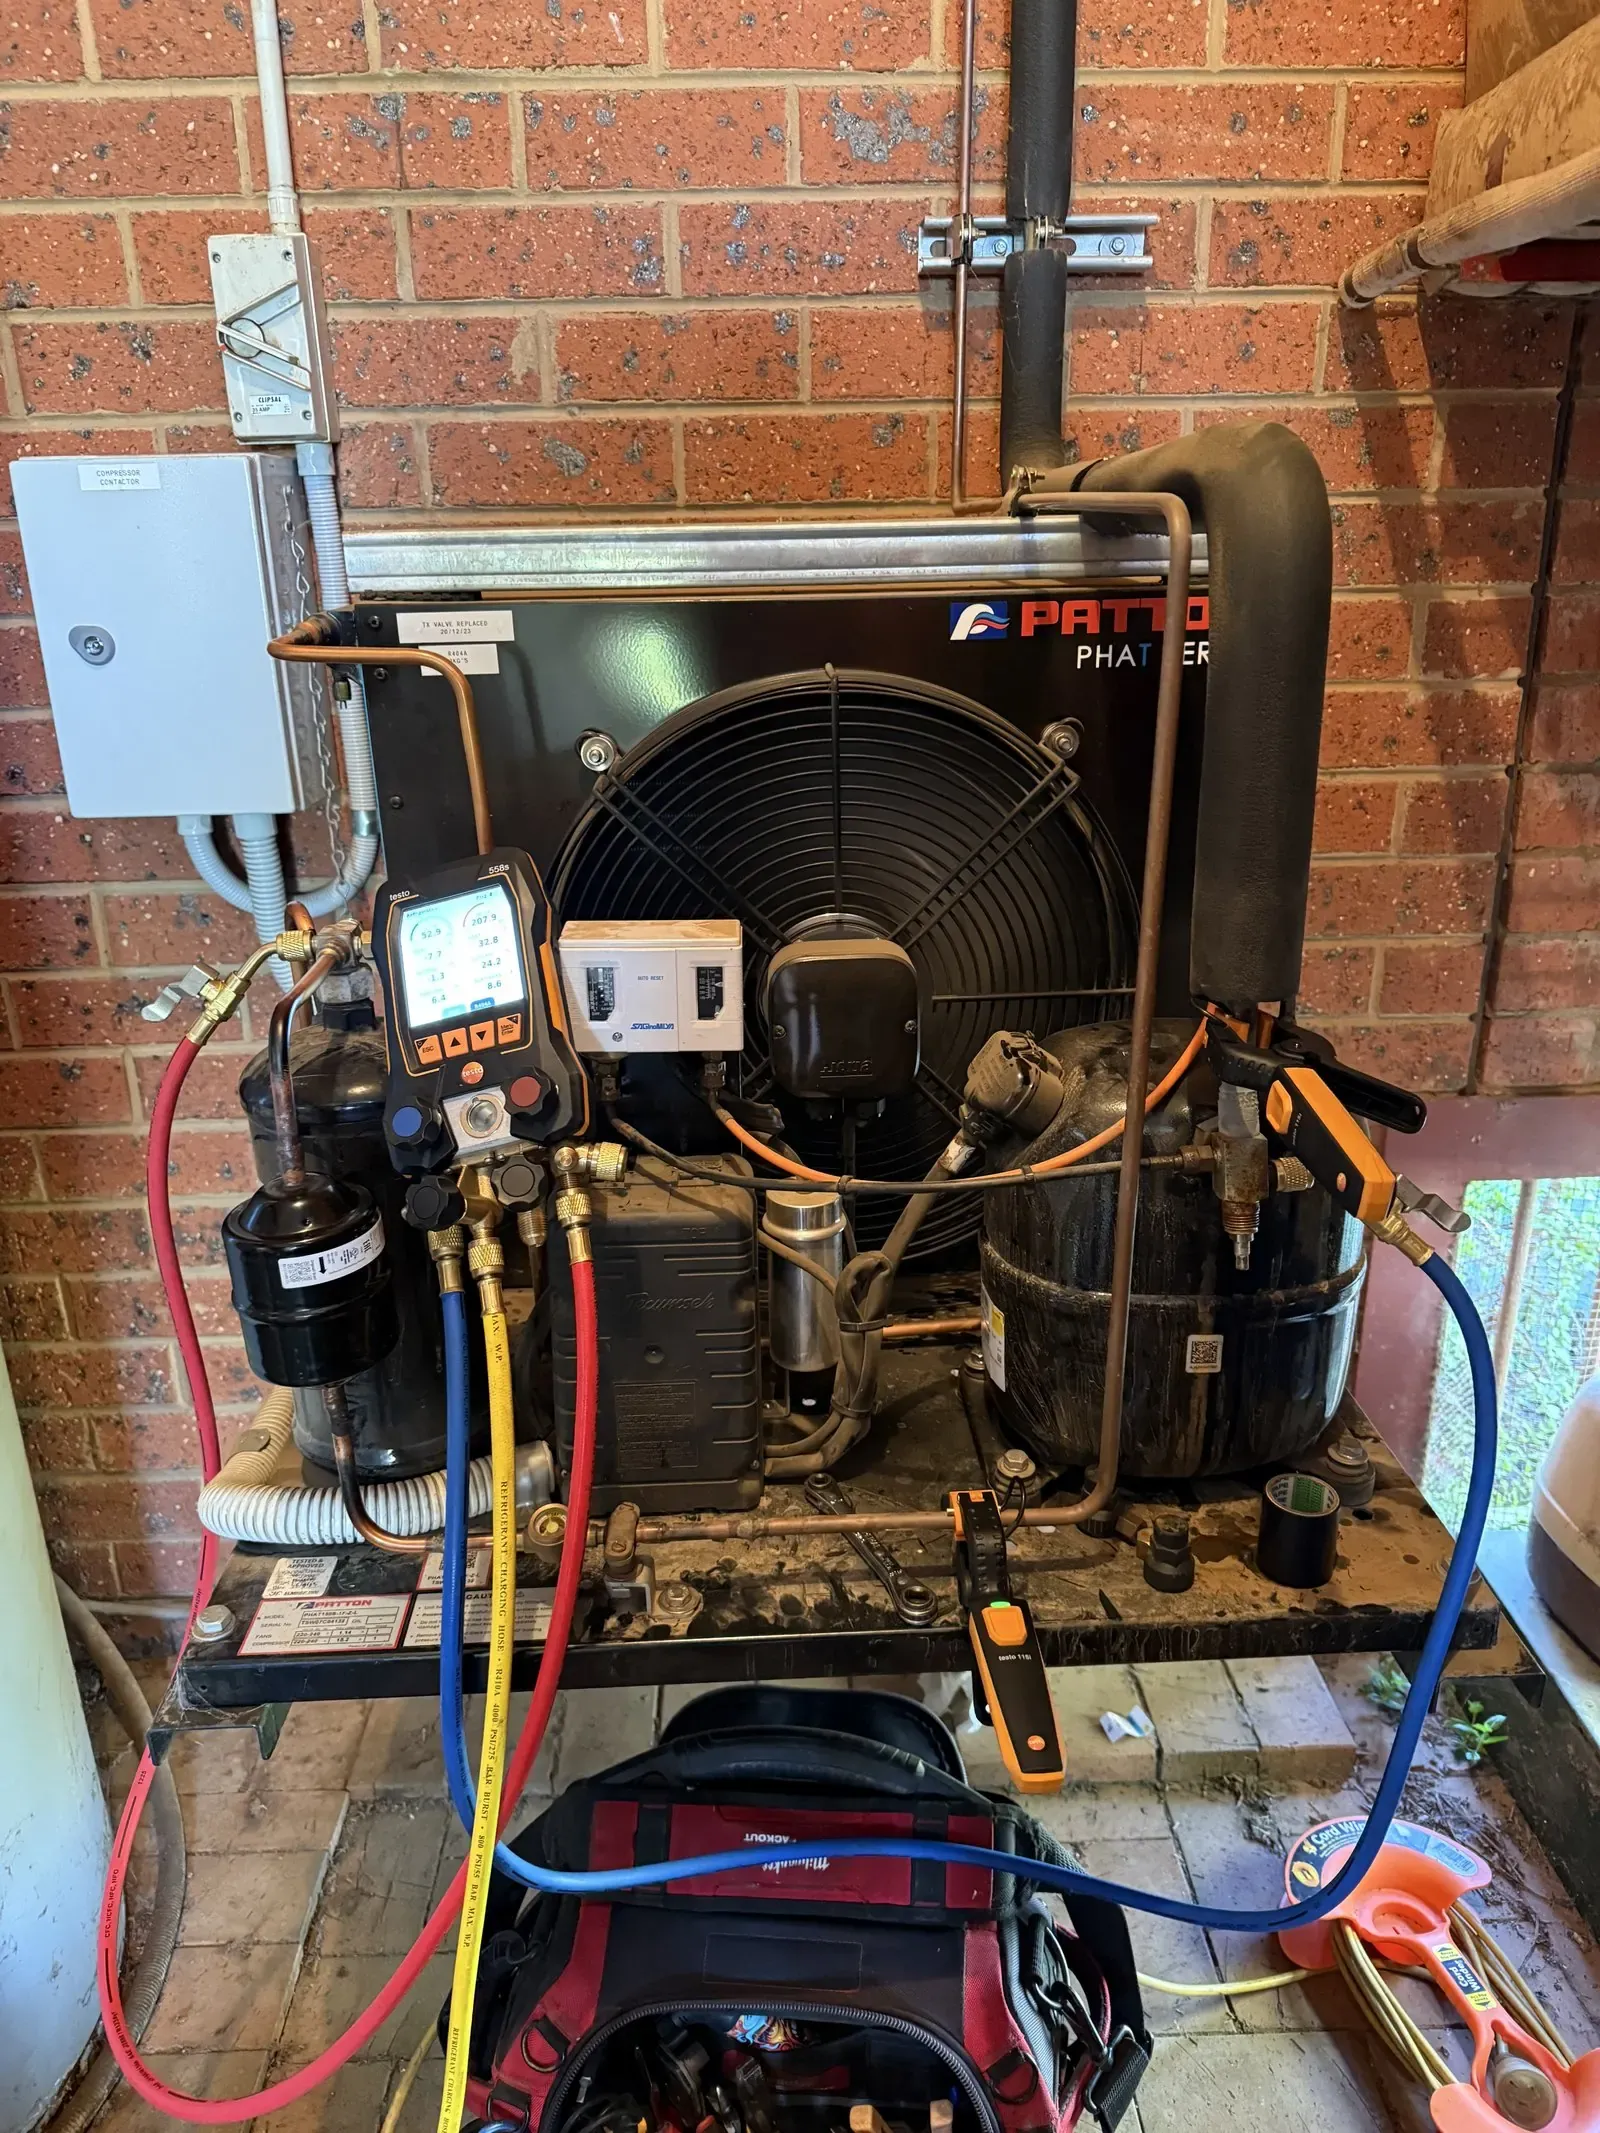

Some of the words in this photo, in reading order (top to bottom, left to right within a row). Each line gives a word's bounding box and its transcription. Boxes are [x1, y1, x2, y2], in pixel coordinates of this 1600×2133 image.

[96, 469, 141, 477] COMPRESSOR
[100, 478, 140, 486] CONTACTOR
[1021, 596, 1210, 637] PATTO
[433, 620, 453, 628] VALVE
[1076, 643, 1152, 669] PHAT
[488, 864, 510, 875] 558s
[389, 889, 411, 901] testo
[471, 914, 498, 927] 207.9
[421, 928, 442, 940] 52.9
[478, 936, 499, 948] 32.8
[481, 957, 502, 969] 24.2
[487, 980, 502, 990] 8.6
[431, 994, 447, 1005] 6.4
[422, 1045, 434, 1054] ESC
[500, 1481, 509, 1555] REFRIGERANT
[499, 1561, 509, 1617] CHARGING
[315, 1600, 373, 1608] PATTON
[497, 1625, 506, 1652] HOSE
[493, 1668, 503, 1697] R410A
[491, 1703, 500, 1723] 4000
[484, 1766, 494, 1785] BAR
[481, 1791, 491, 1821] BURST
[743, 1833, 797, 1844] ACKOUT
[1310, 1822, 1341, 1845] Cord
[1340, 1820, 1366, 1836] Win
[477, 1835, 485, 1849] 800
[469, 1884, 479, 1901] BAR
[1449, 1966, 1469, 1987] Cord
[448, 2027, 460, 2075] REFRIGERANT
